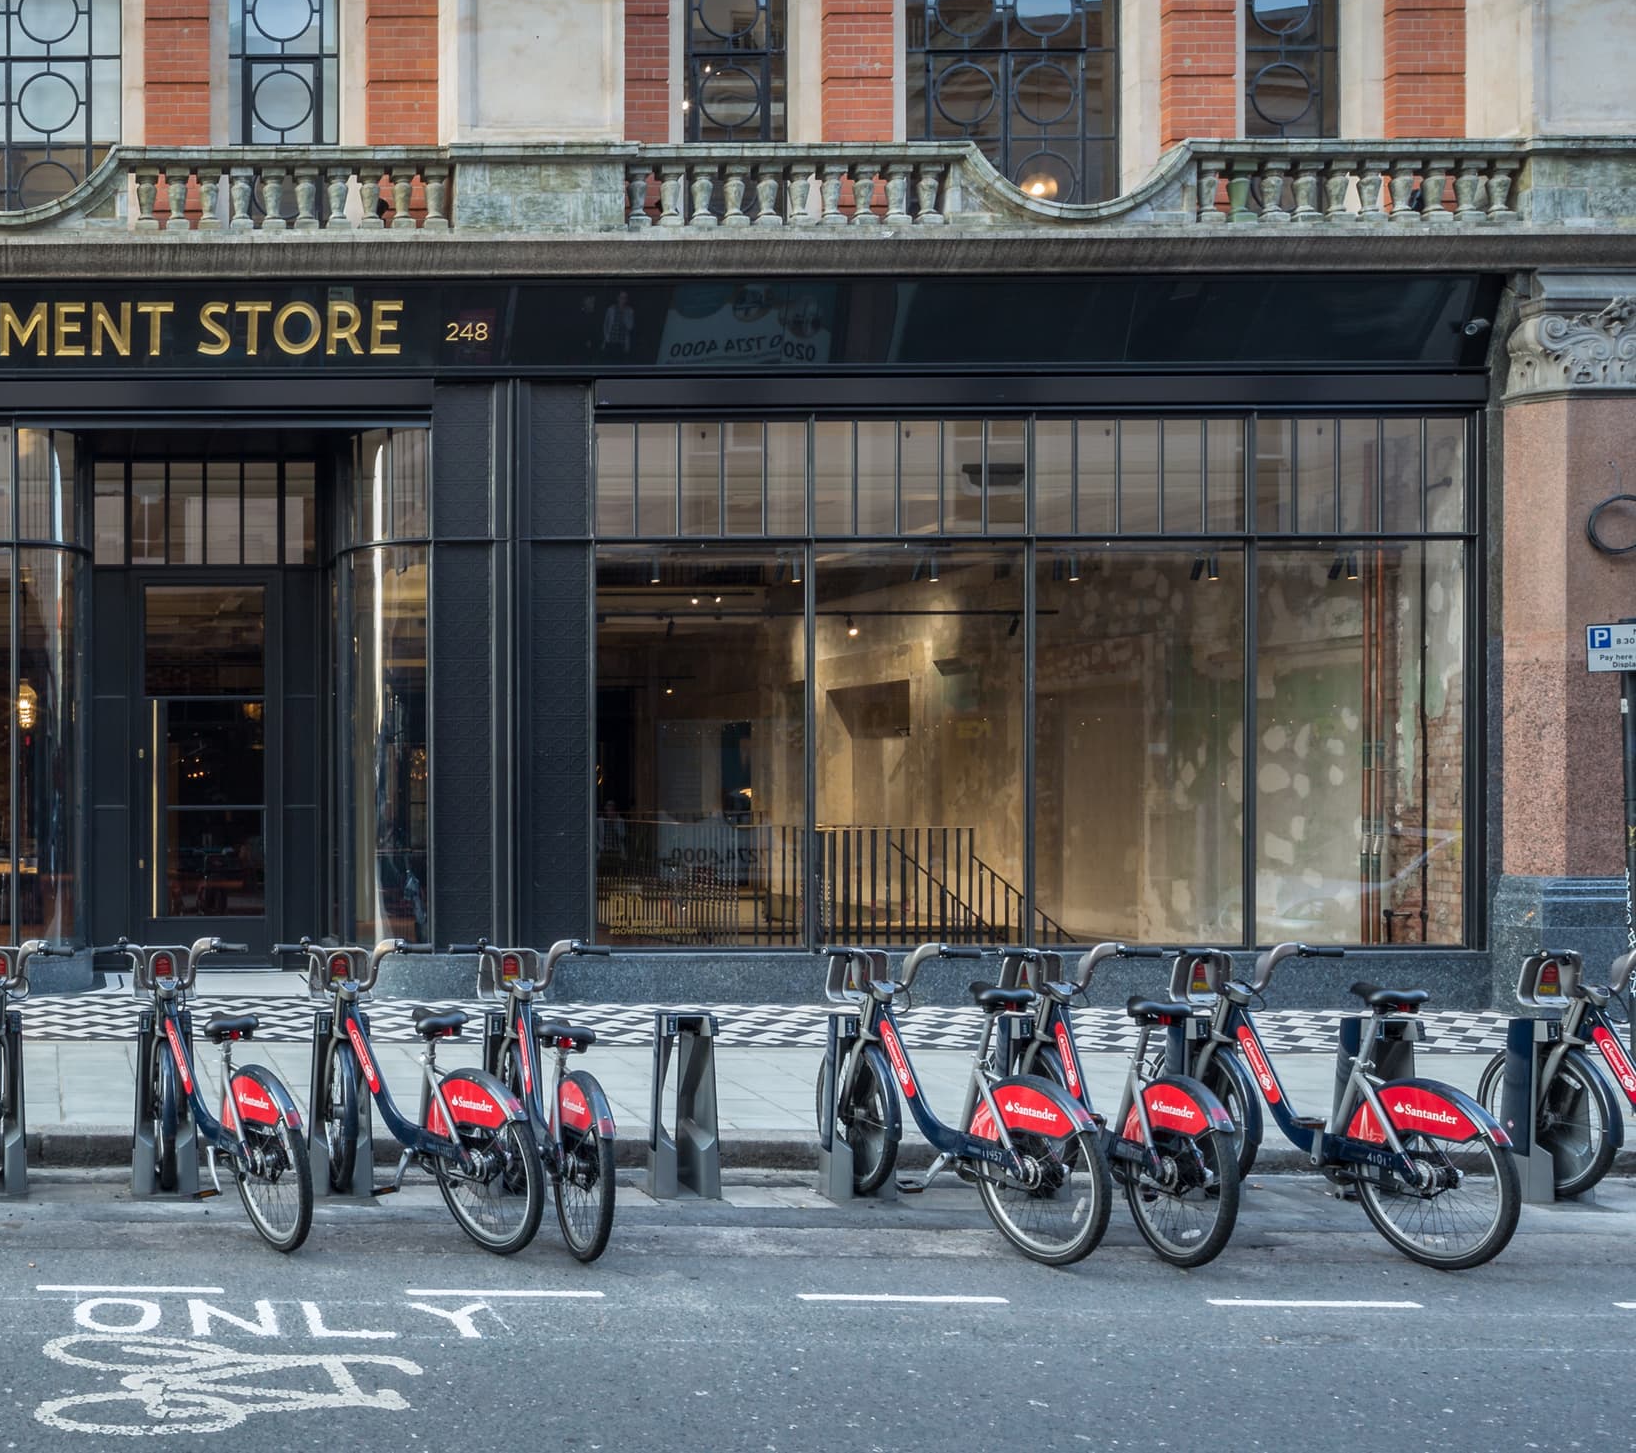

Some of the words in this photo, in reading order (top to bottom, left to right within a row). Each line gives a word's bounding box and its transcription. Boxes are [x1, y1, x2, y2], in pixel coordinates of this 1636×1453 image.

[197, 299, 404, 356] STORE
[445, 322, 490, 342] 248
[1595, 630, 1608, 647] P
[458, 1096, 493, 1114] Santander
[1013, 1102, 1058, 1122] Santander
[1157, 1102, 1195, 1119] Santander
[1404, 1104, 1458, 1125] Santander
[73, 1297, 490, 1339] ONLY
